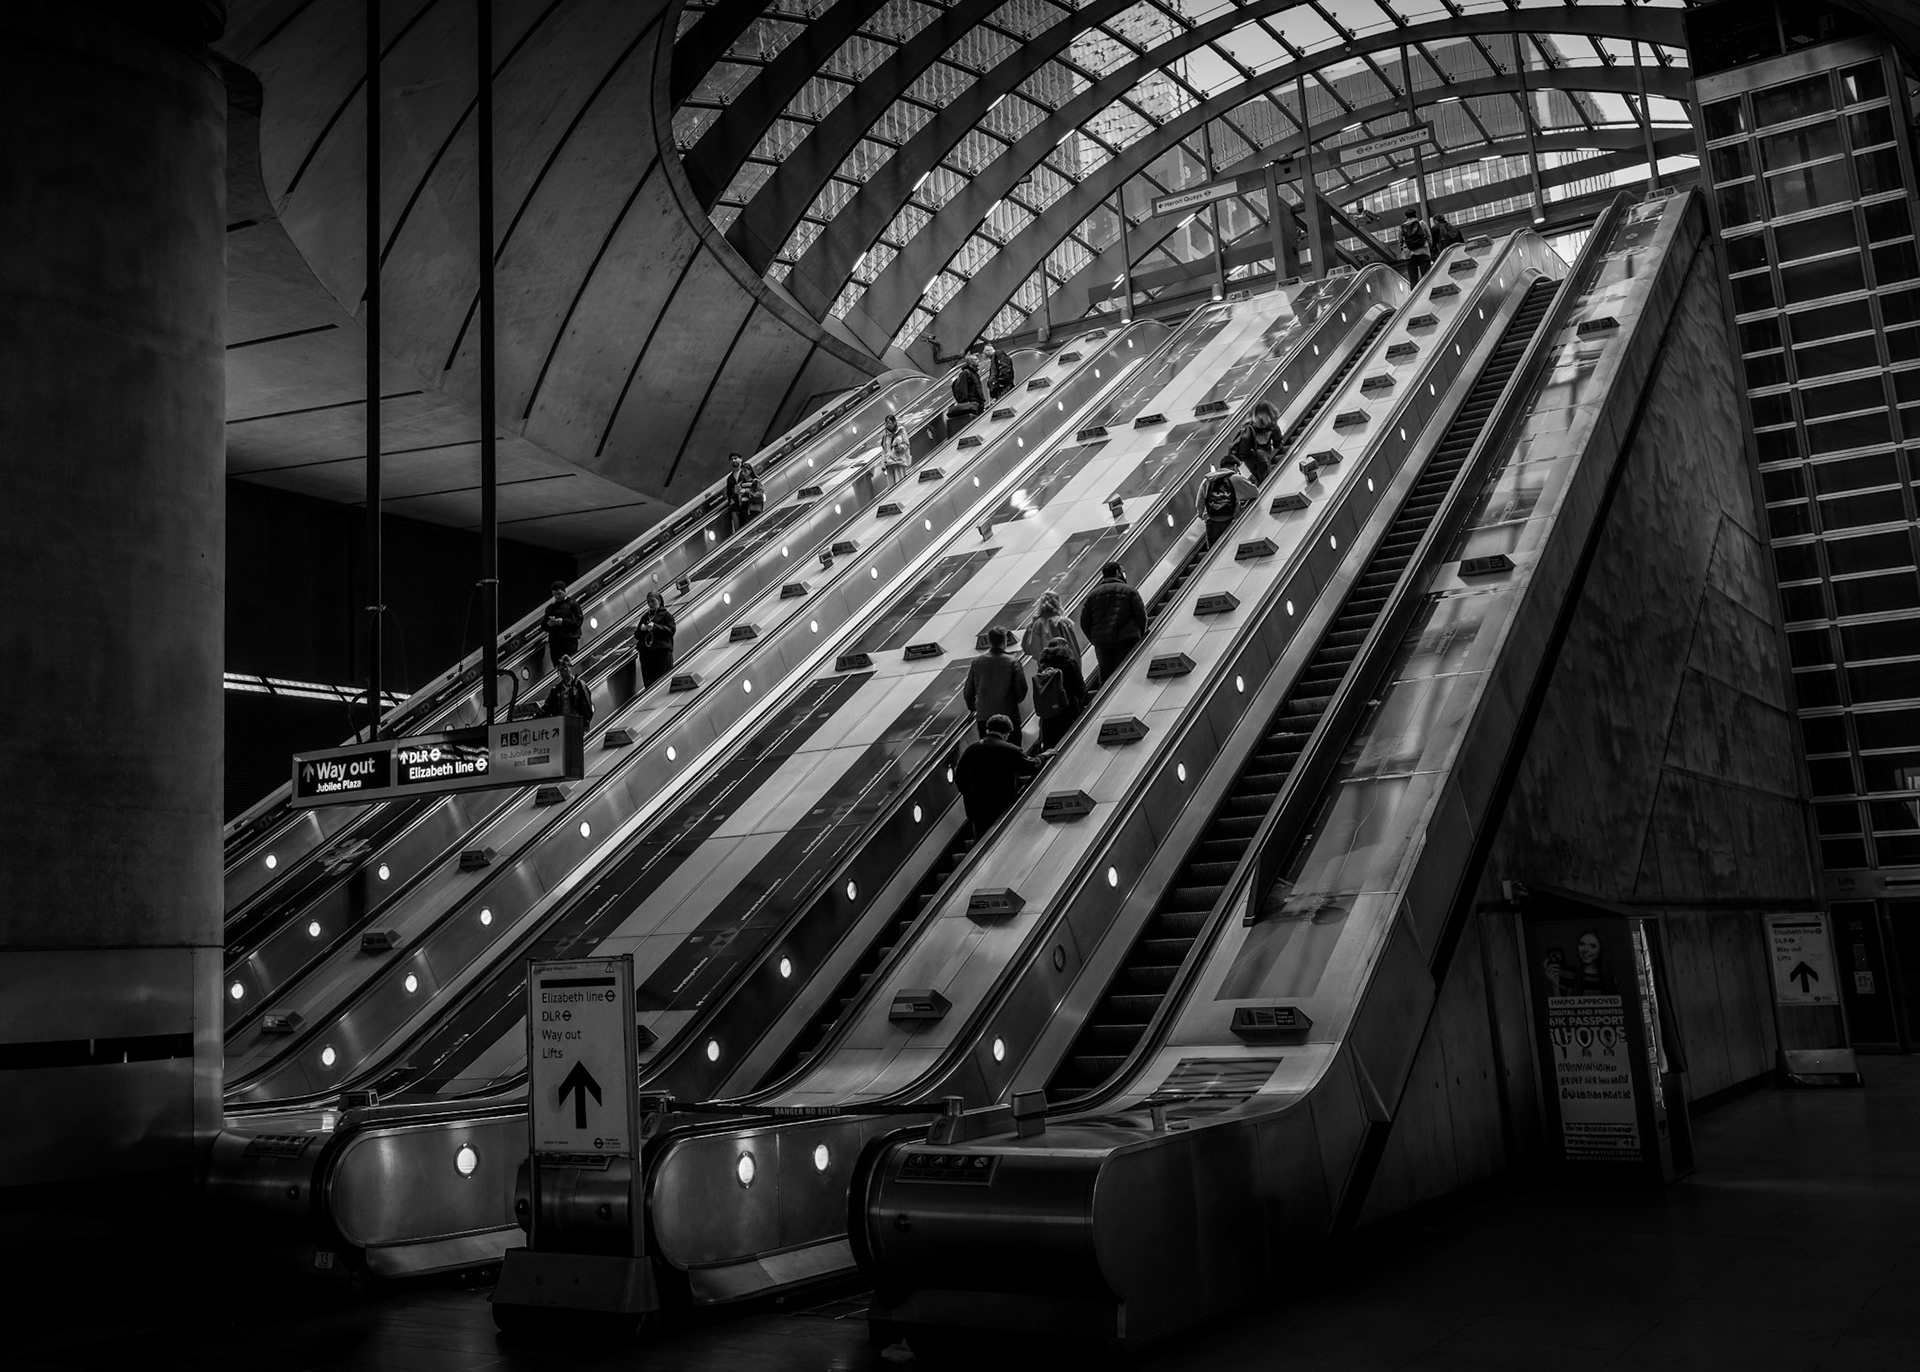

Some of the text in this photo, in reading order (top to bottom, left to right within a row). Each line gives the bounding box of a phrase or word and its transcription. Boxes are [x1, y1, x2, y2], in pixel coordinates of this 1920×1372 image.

[1374, 132, 1420, 149] Canary Wharf
[1164, 193, 1203, 207] Heron Quays
[532, 730, 550, 742] Lift
[408, 750, 429, 764] DLR
[508, 750, 532, 758] Jubilee
[316, 757, 376, 781] Way out
[409, 760, 474, 780] Elizabeth line
[315, 780, 362, 793] Jubilee Plaza
[542, 991, 604, 1004] Elizabeth line
[542, 1010, 561, 1022] DLR
[1568, 1015, 1625, 1026] PASSPORT
[542, 1030, 582, 1042] Way out
[542, 1048, 563, 1059] Lifts
[774, 1107, 841, 1116] DANGER NO ENTRY
